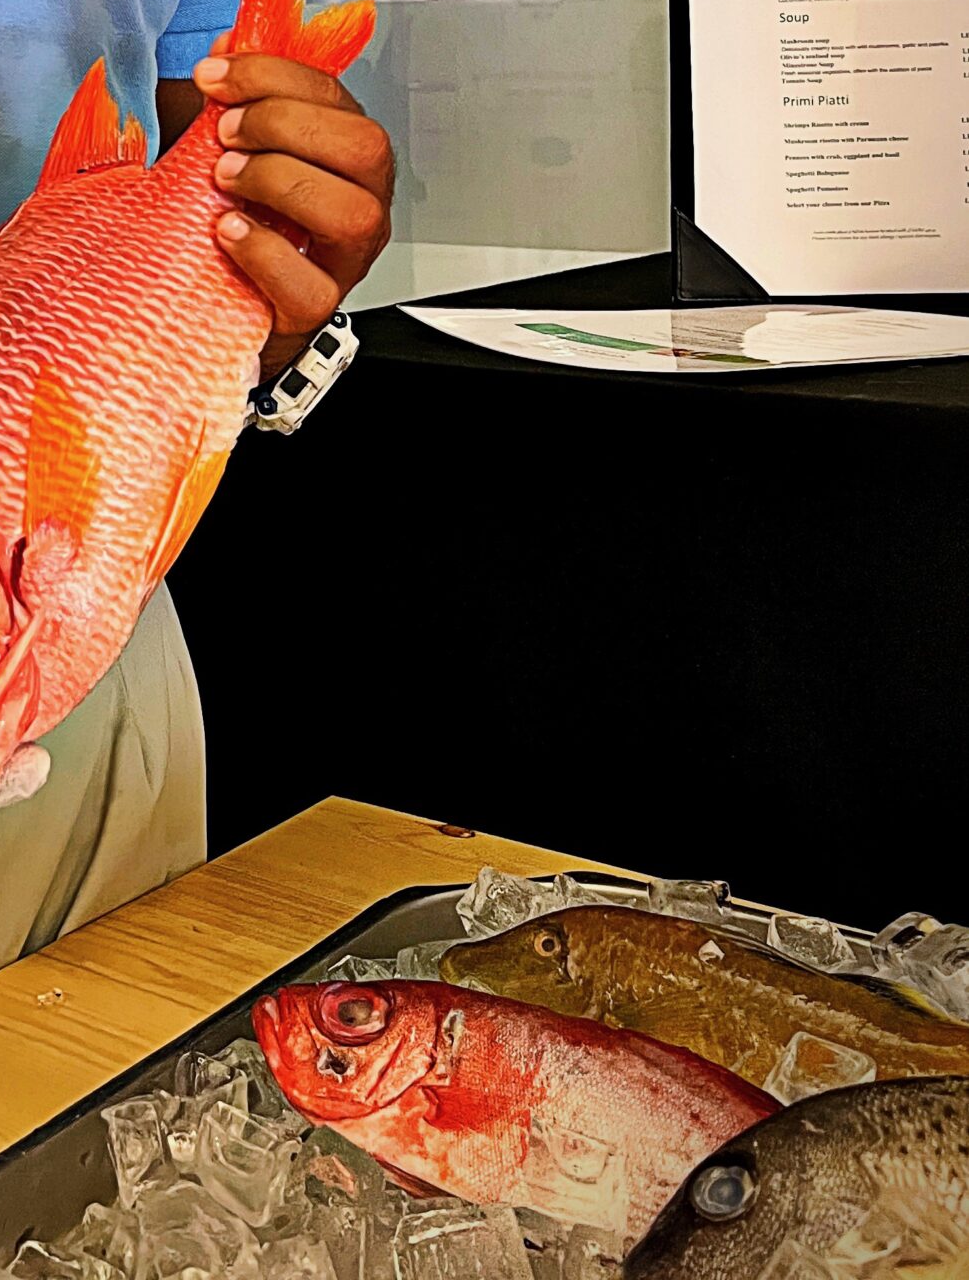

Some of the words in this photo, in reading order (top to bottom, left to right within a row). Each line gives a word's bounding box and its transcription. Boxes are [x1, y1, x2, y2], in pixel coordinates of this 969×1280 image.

[779, 12, 810, 24] Soup
[783, 96, 814, 106] Primi
[818, 95, 849, 105] Piatti
